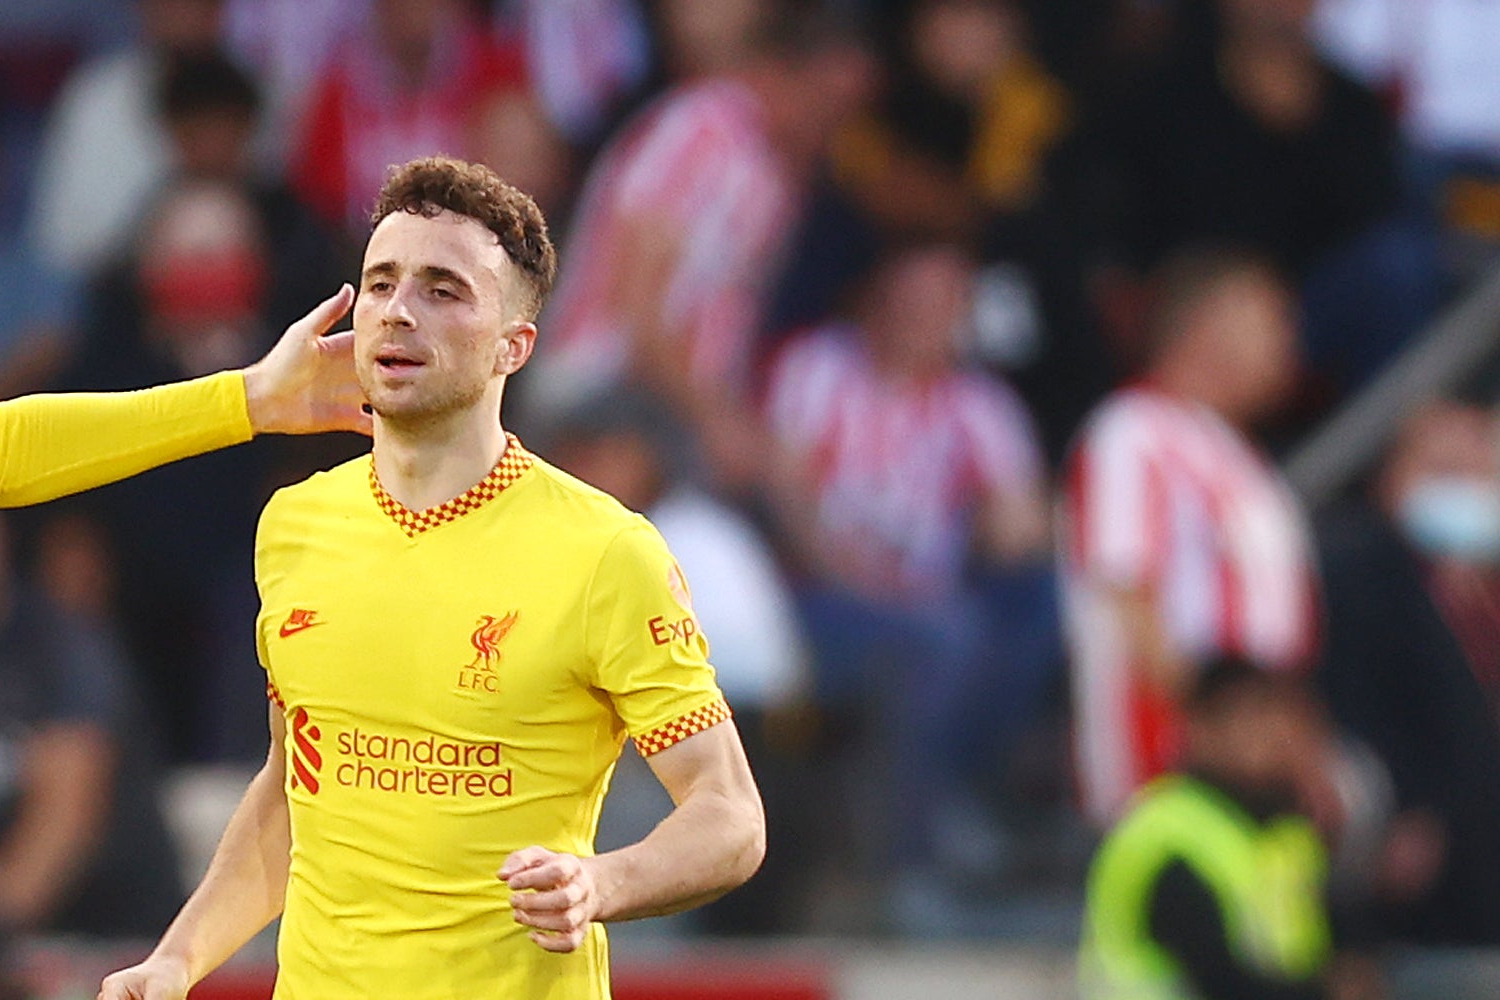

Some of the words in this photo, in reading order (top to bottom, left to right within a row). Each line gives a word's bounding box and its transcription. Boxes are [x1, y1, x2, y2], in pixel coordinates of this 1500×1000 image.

[647, 615, 696, 647] Exp
[337, 728, 501, 768] standard
[336, 759, 513, 798] chartered
